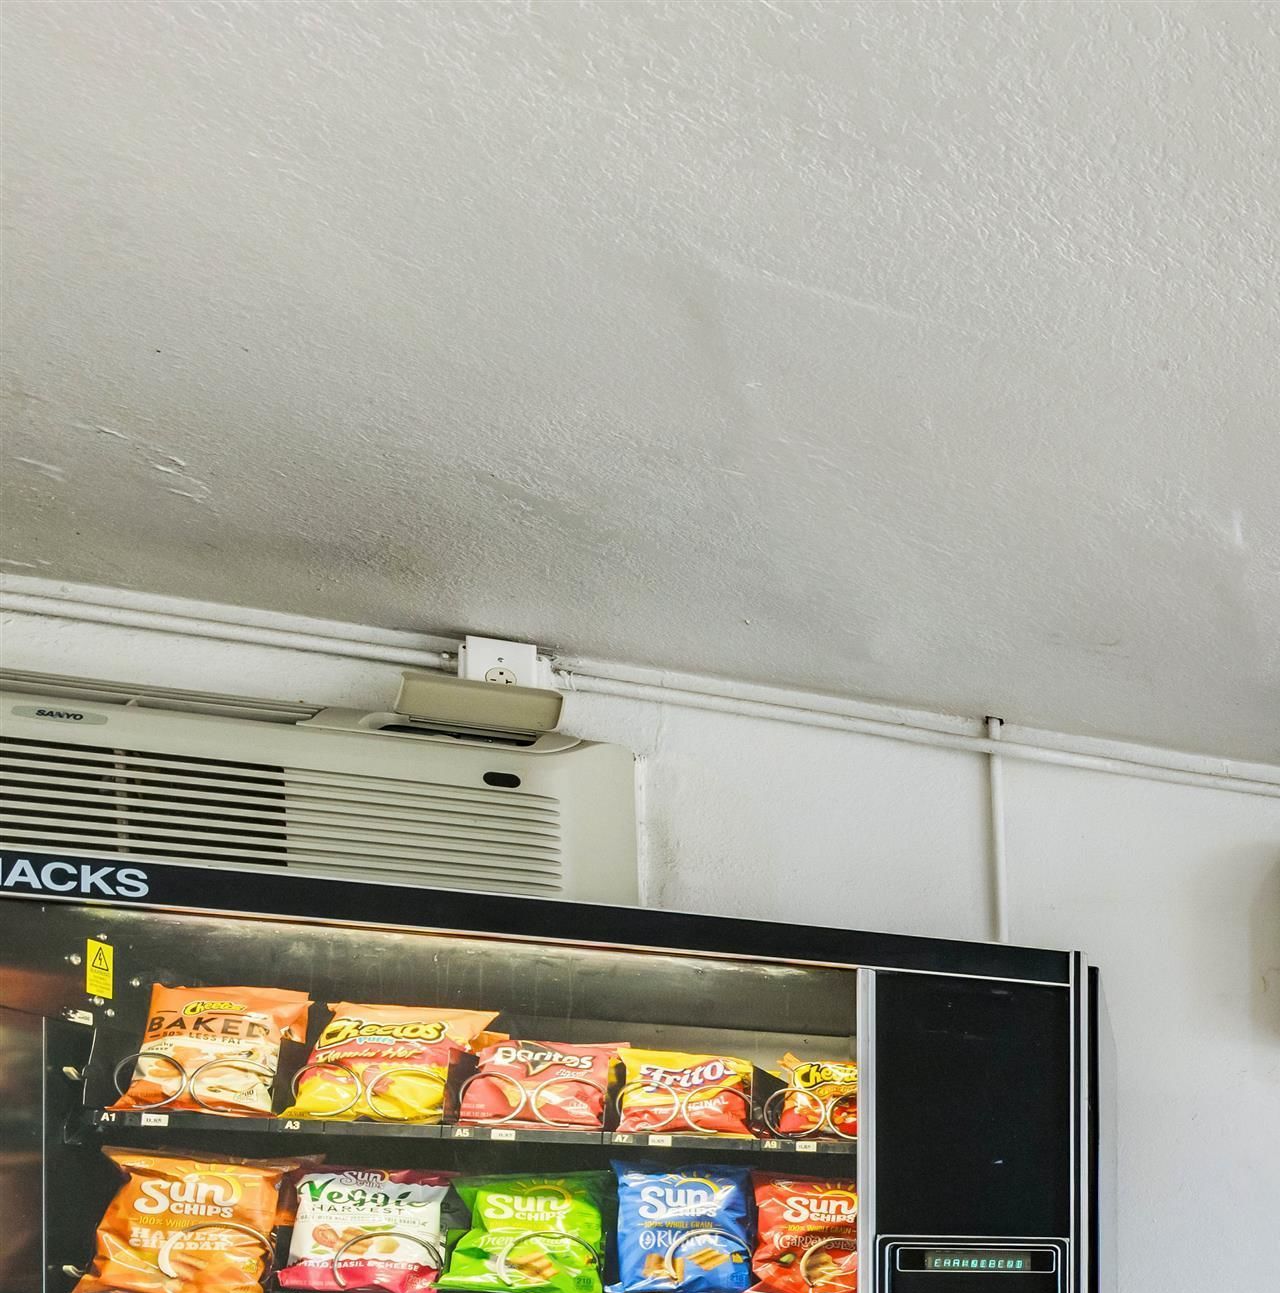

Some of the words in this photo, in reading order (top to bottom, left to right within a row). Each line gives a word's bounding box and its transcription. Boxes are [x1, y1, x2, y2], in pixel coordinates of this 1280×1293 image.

[35, 709, 84, 721] SANYO
[0, 858, 149, 897] ACKS
[148, 1017, 270, 1038] BAKED
[188, 1032, 217, 1041] LESS
[222, 1036, 242, 1044] FAT
[495, 1046, 594, 1070] Doritos
[101, 1112, 115, 1121] A1
[285, 1121, 300, 1130] A3
[455, 1129, 470, 1137] A5
[614, 1135, 628, 1143] A7
[340, 1171, 389, 1185] Sun
[134, 1173, 242, 1214] Sun
[484, 1194, 573, 1219] Sun
[639, 1185, 729, 1219] Sun
[169, 1203, 233, 1218] CHIPS
[312, 1204, 407, 1214] HARVEST
[783, 1196, 857, 1223] Sun
[514, 1212, 567, 1222] CHIPS
[811, 1213, 856, 1223] CHIPS
